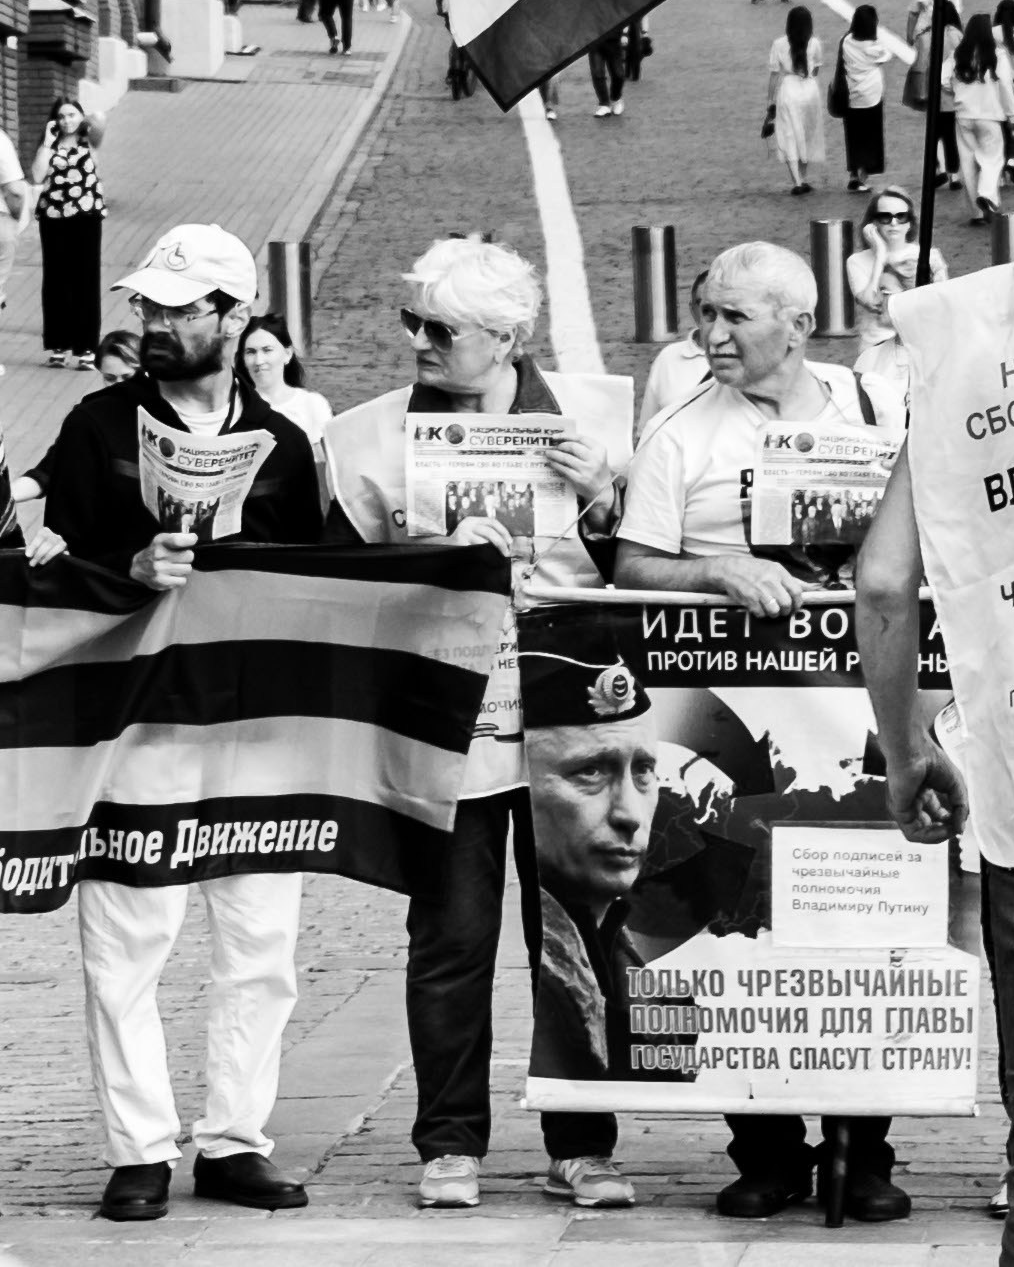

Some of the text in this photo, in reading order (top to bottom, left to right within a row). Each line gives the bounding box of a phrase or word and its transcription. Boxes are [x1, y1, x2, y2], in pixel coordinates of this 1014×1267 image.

[648, 651, 738, 672] ПРОТИВ
[746, 647, 837, 672] НАШЕЙ
[169, 818, 339, 869] Движение
[792, 848, 923, 863] Сбор подписей за
[791, 866, 900, 879] чрезвычайные
[791, 884, 882, 895] полномочия
[792, 898, 930, 916] Владимиру Путину
[626, 963, 969, 999] ТОЛЬКО ЧРЕЗВЫЧАЙНЫЕ
[630, 1005, 974, 1039] ПОЛНОМОЧИЯ ДЛЯ ГЛАВЫ
[630, 1044, 972, 1076] ГОСУДАРСТВА СПАСУТ СТРАНУ!
